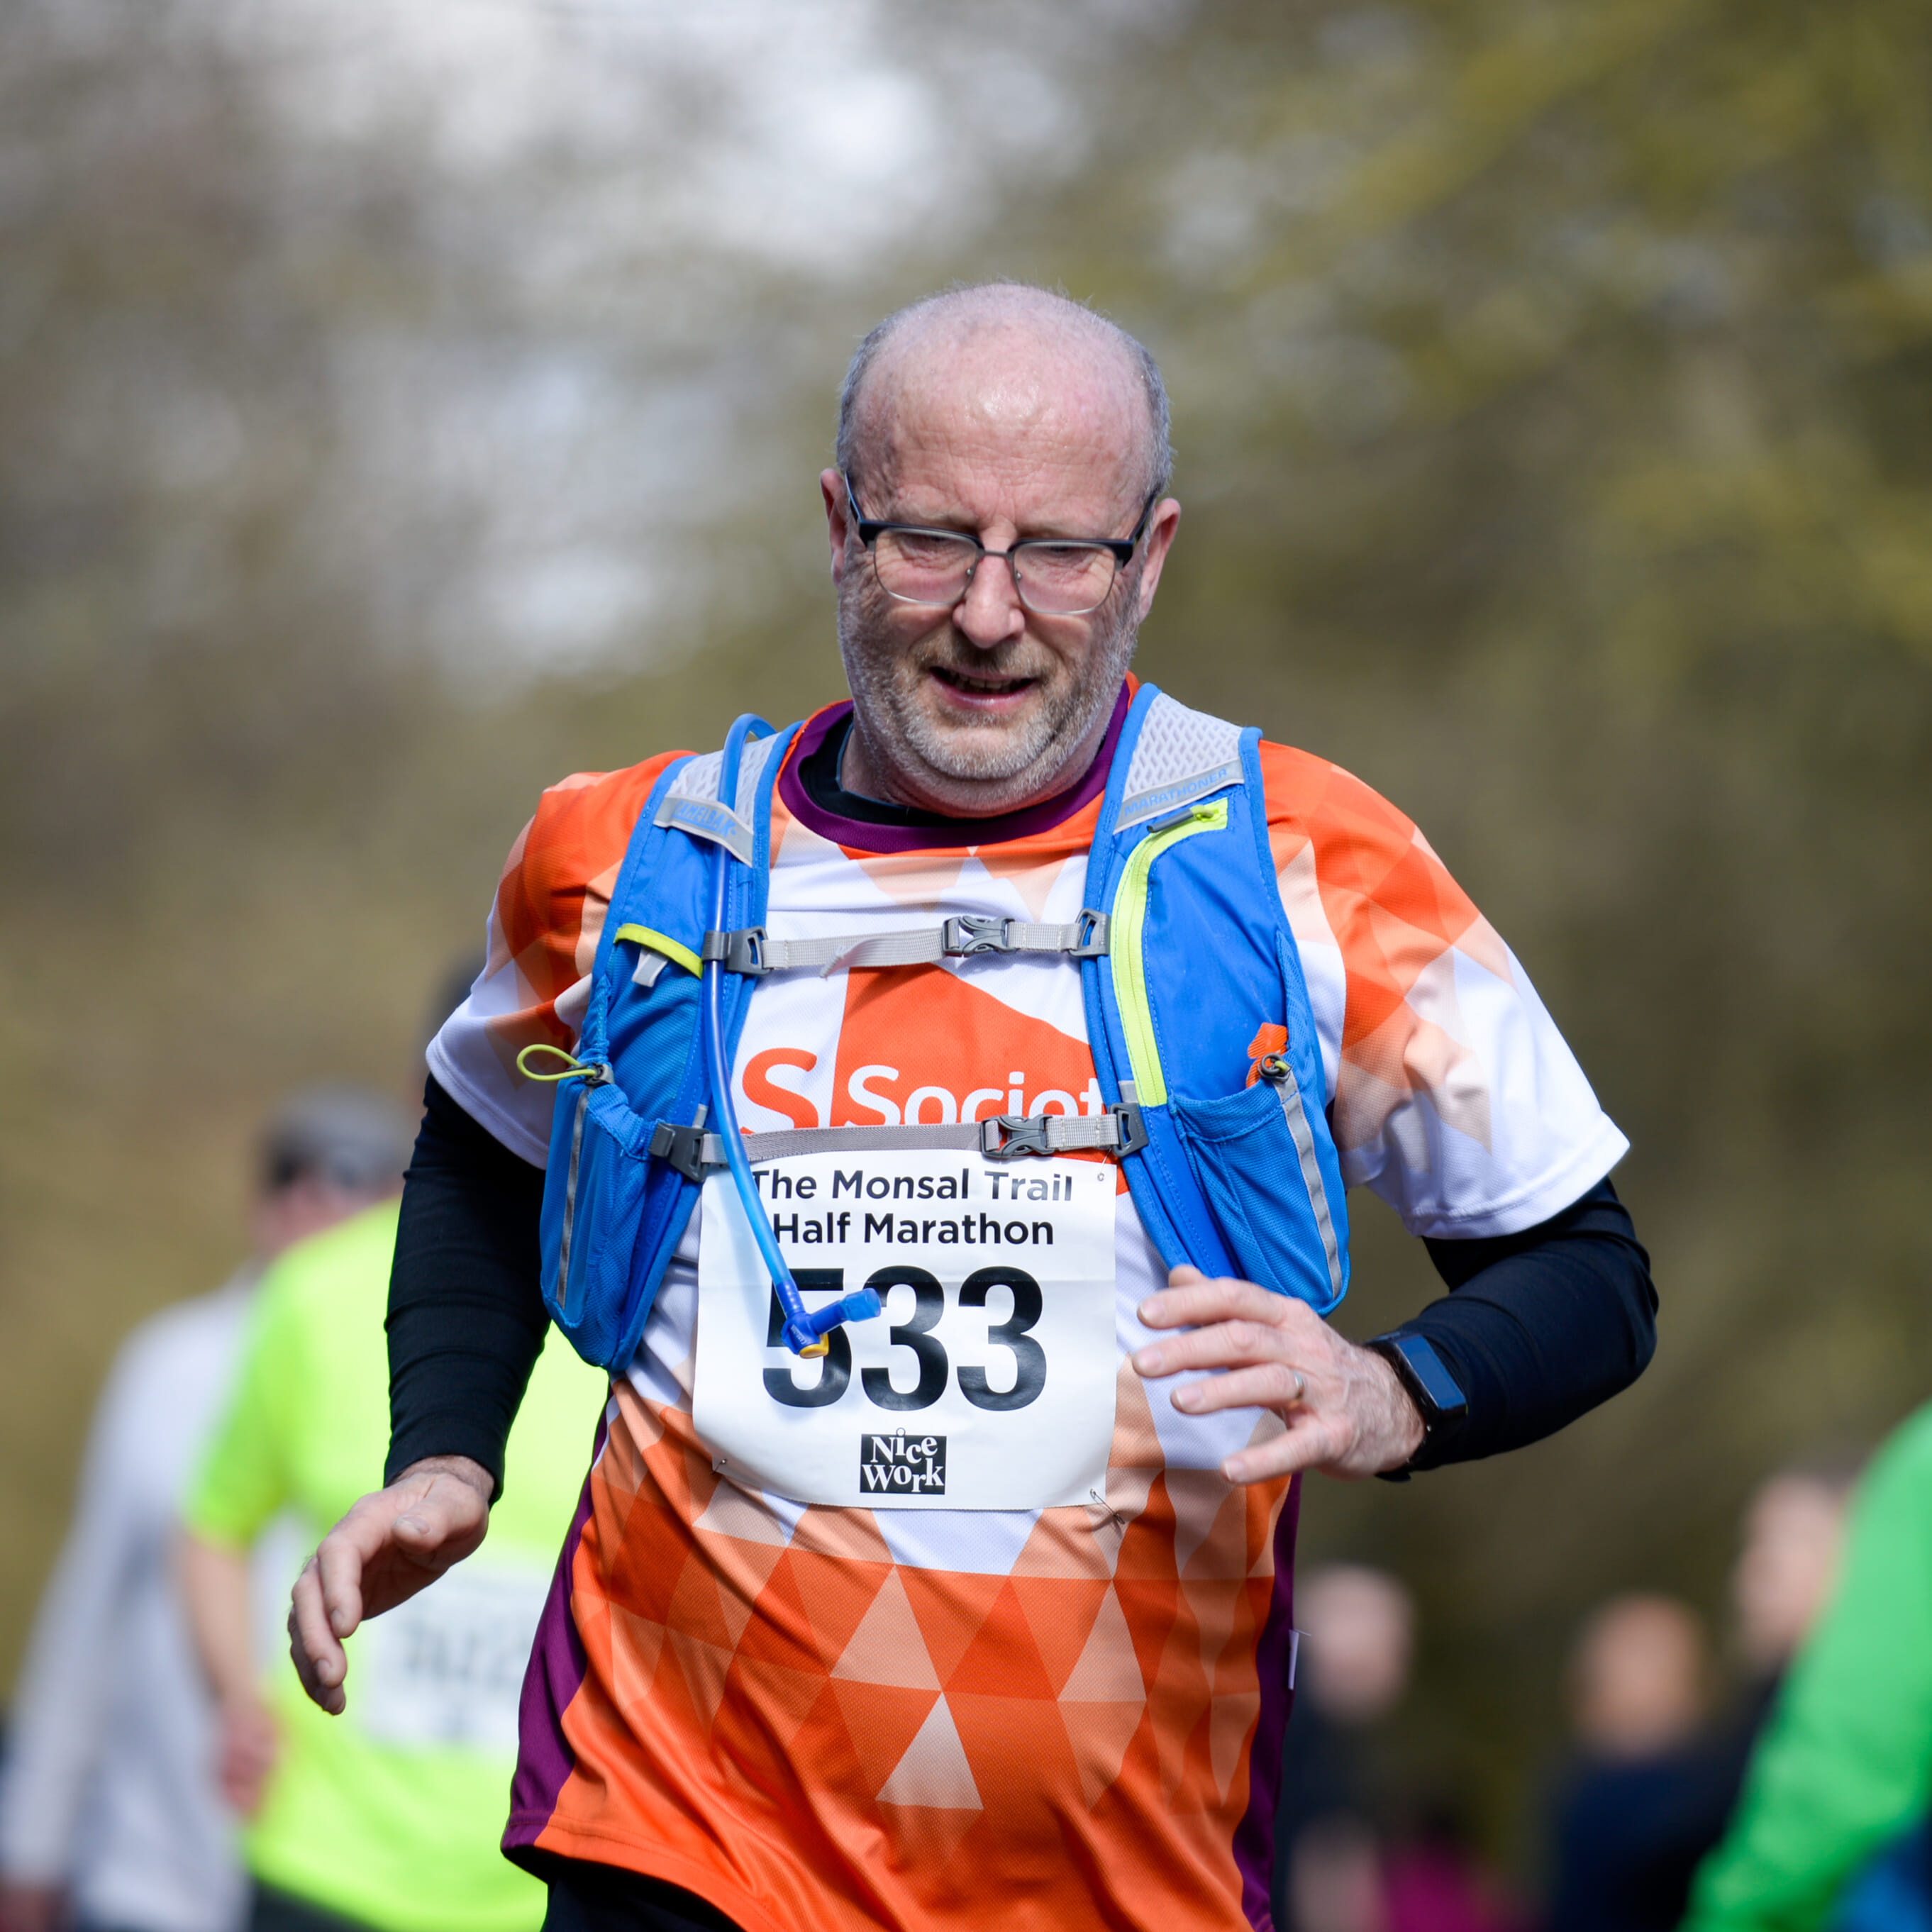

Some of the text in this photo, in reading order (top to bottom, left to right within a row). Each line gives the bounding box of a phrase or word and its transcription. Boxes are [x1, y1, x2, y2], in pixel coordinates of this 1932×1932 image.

[1124, 767, 1228, 817] MARATHONER
[752, 1167, 1072, 1201] The Monsal Trail
[773, 1211, 1054, 1245] Half Marathon
[762, 1265, 1048, 1411] 533
[870, 1427, 938, 1464] Nice
[860, 1458, 945, 1493] Work
